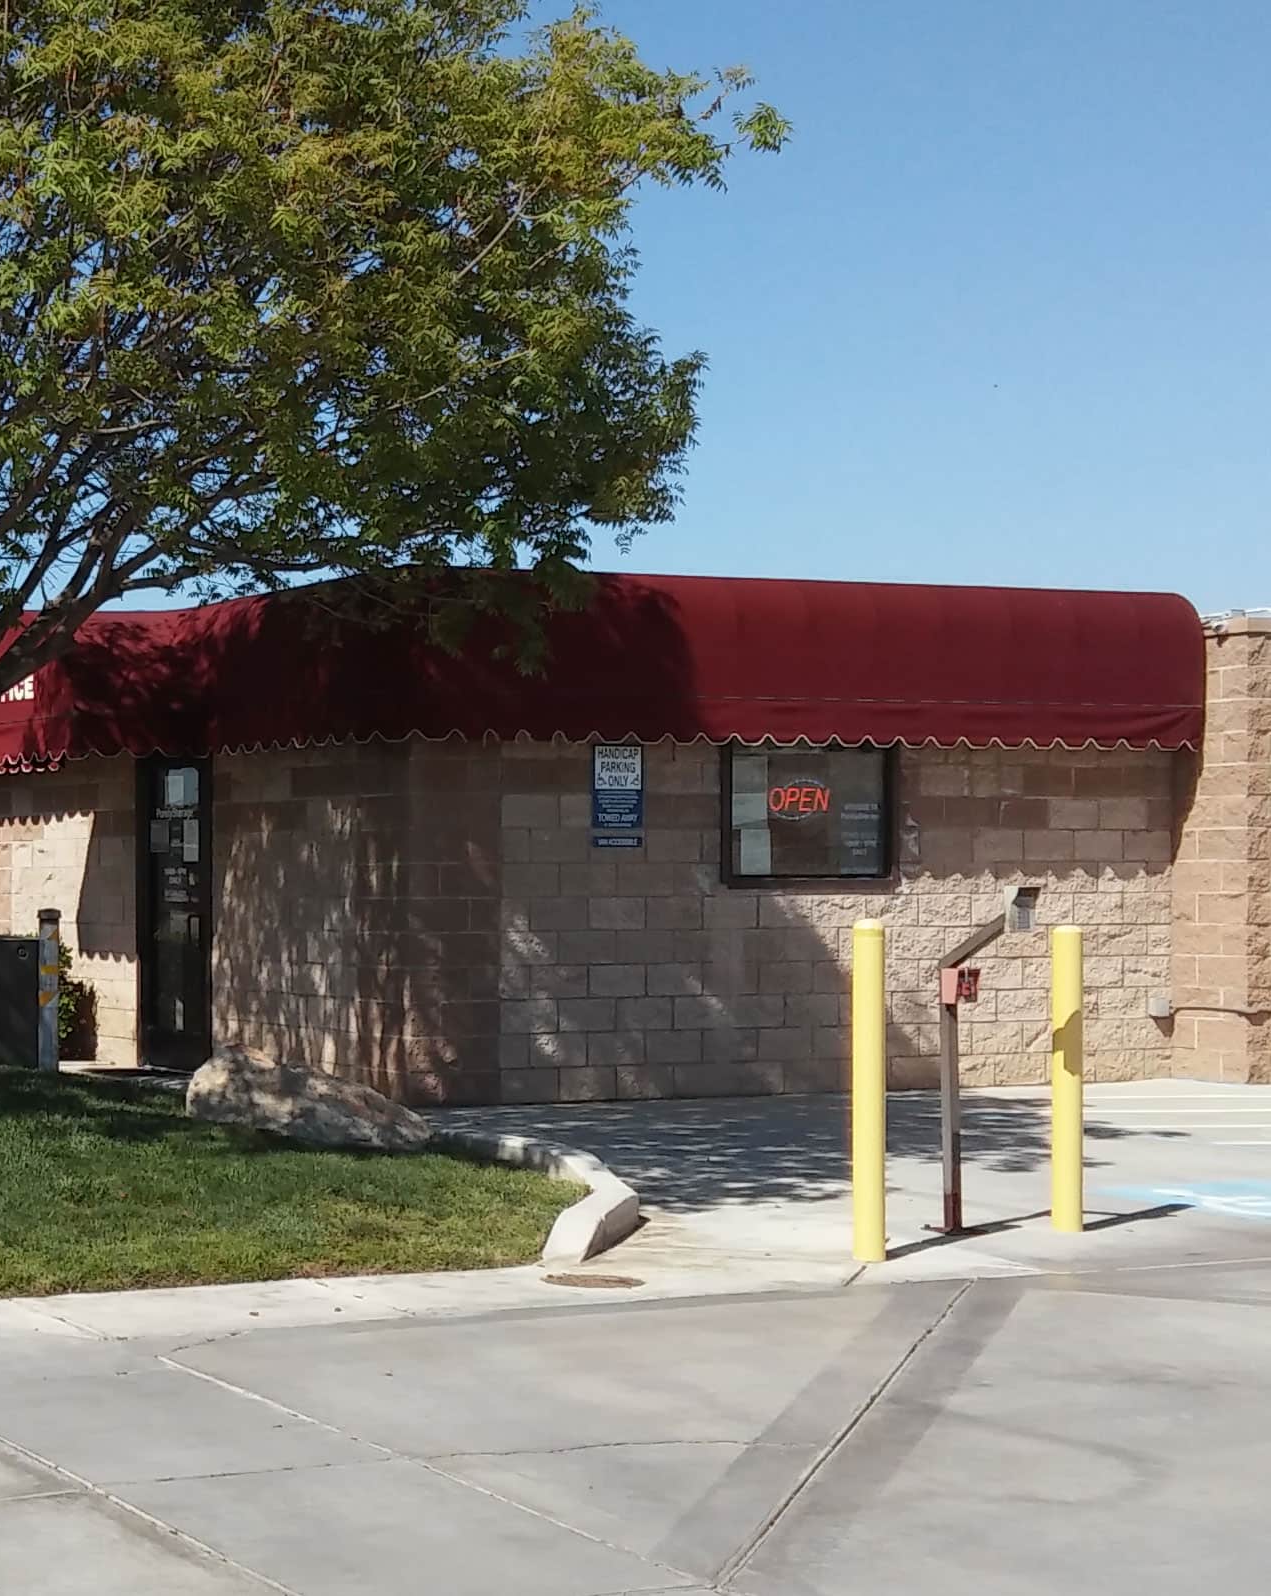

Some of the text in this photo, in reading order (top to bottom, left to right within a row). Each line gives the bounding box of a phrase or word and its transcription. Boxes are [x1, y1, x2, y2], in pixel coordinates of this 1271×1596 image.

[597, 748, 639, 760] HANDICAP
[600, 761, 636, 773] PARKING
[607, 775, 629, 788] ONLY
[769, 788, 830, 812] OPEN
